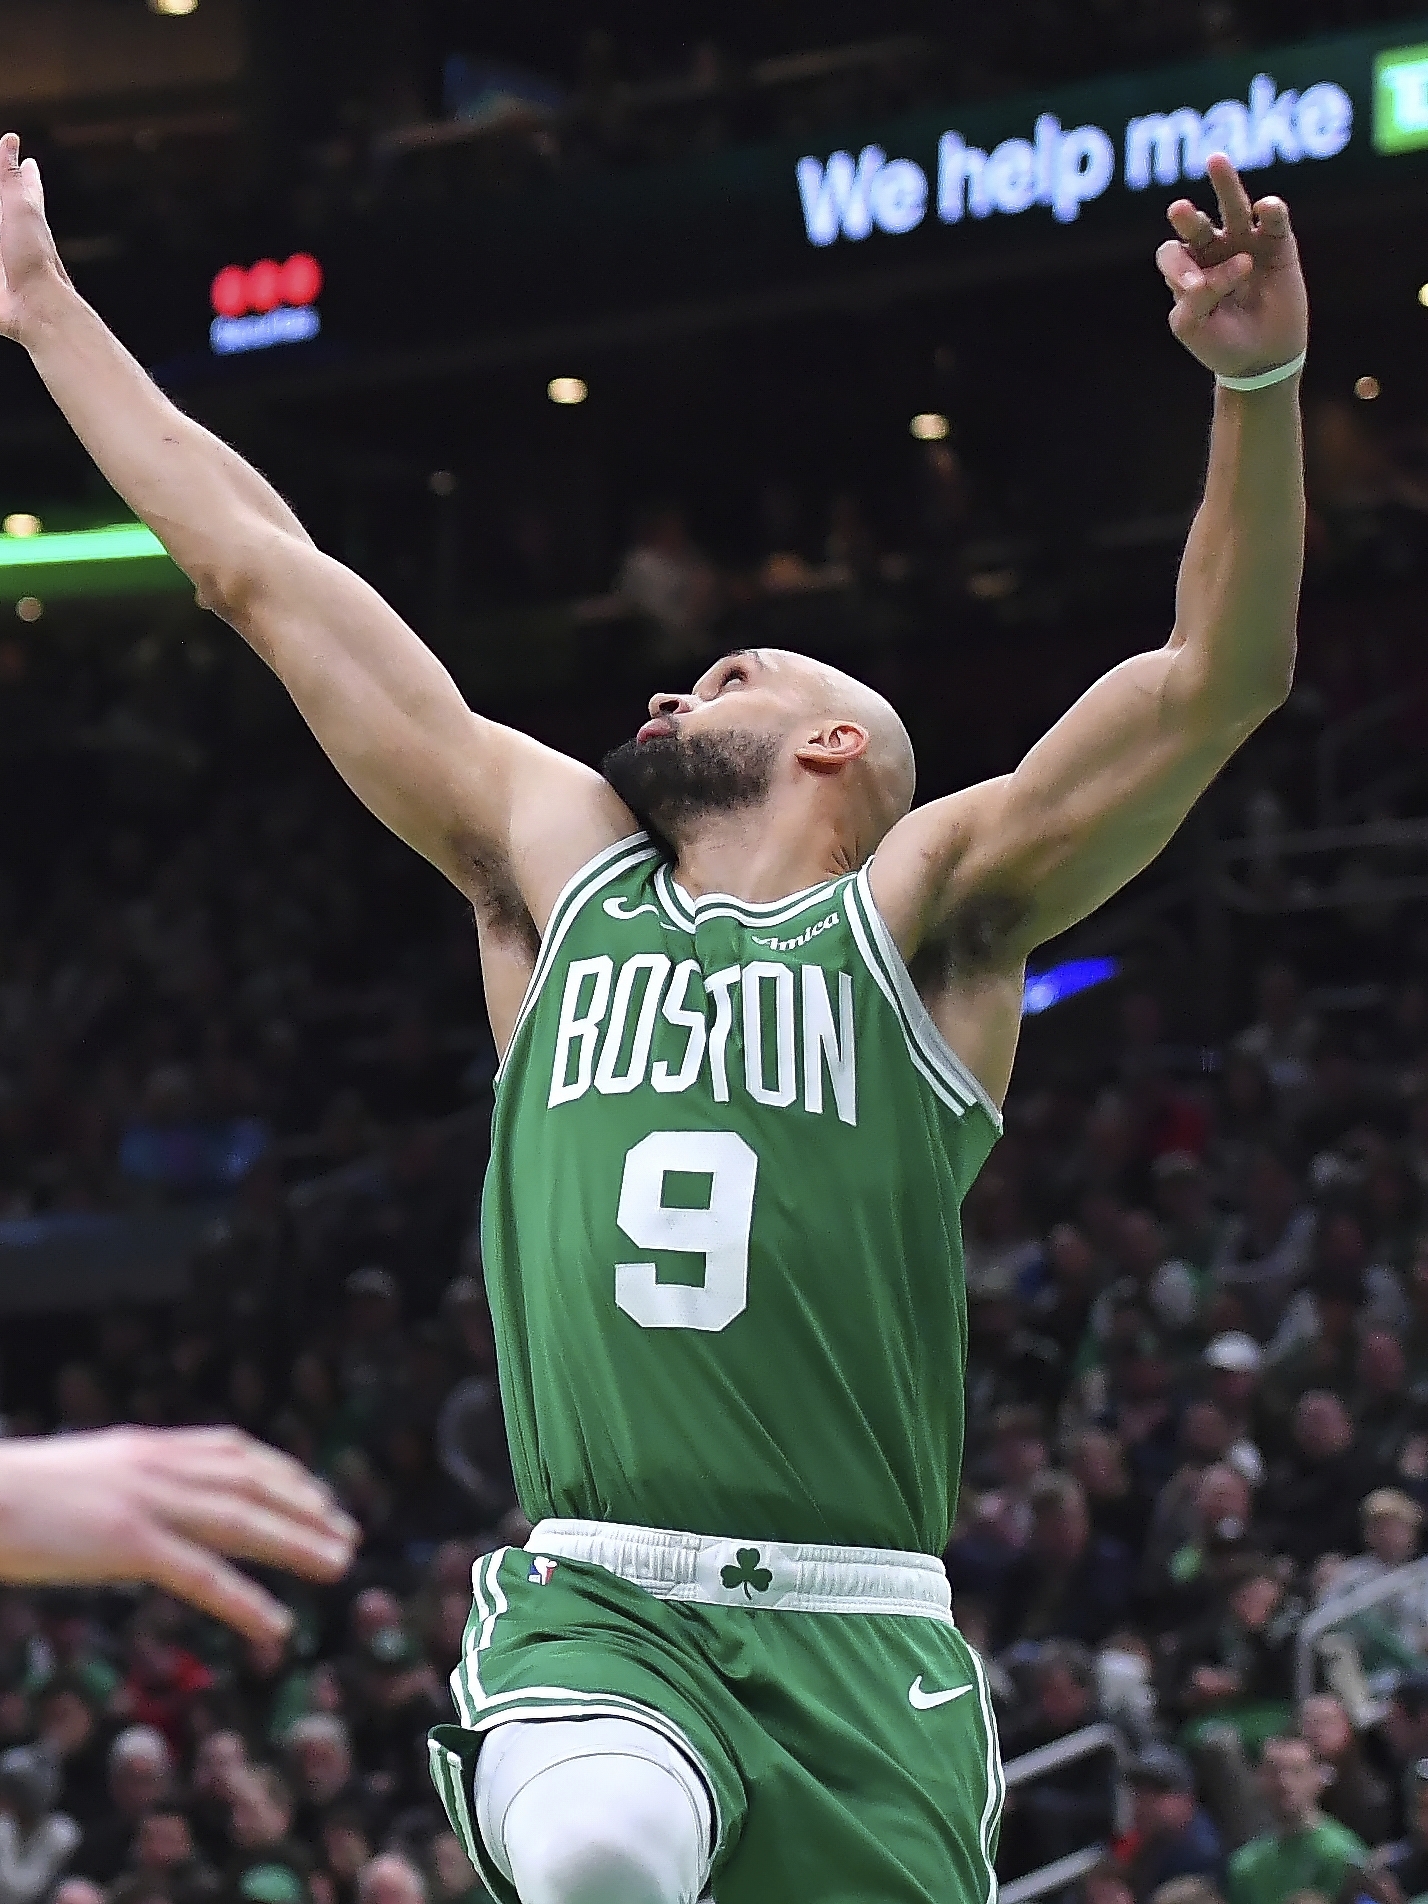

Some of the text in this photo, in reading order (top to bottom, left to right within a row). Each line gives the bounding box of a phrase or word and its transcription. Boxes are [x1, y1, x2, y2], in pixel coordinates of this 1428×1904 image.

[796, 145, 928, 247] We
[936, 113, 1115, 224] help
[1123, 73, 1353, 190] make
[548, 953, 857, 1127] BOSTON
[615, 1131, 758, 1332] 9
